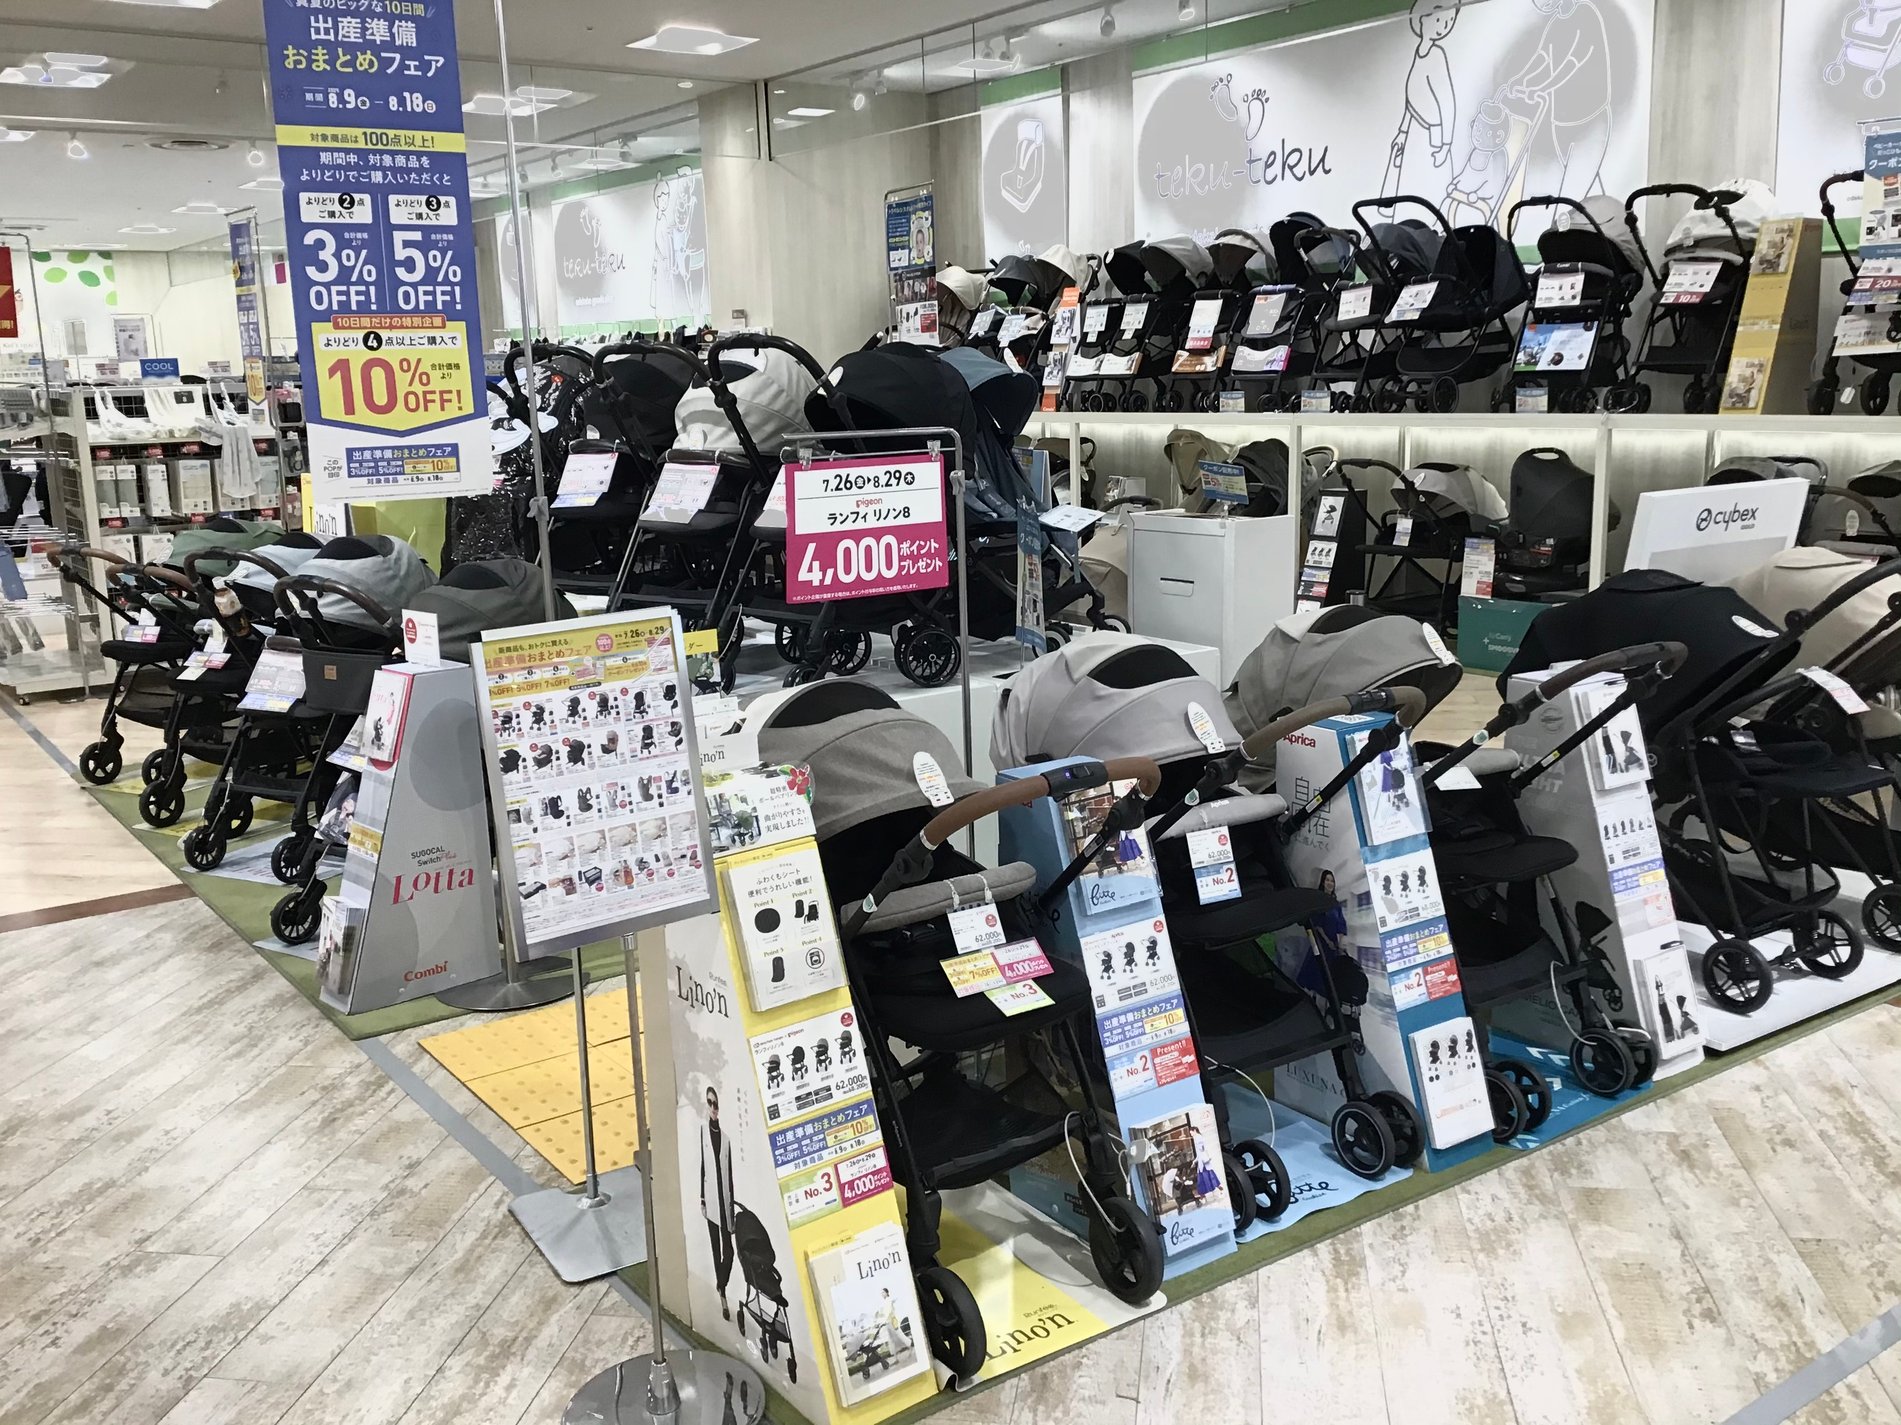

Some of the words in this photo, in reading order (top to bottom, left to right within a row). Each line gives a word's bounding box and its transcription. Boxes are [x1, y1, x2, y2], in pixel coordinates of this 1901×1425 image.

[310, 14, 417, 47] 出産準備
[283, 44, 445, 77] おまとめフェア
[319, 152, 431, 168] 期間中、対象商品を
[1155, 138, 1332, 199] teku-teku
[1868, 158, 1901, 170] クーポ
[300, 168, 452, 186] よりどりでご購入いただくと
[318, 209, 355, 220] ご購入で
[406, 211, 441, 222] ご購入で
[309, 285, 377, 311] OFF!
[397, 285, 462, 311] OFF!
[336, 315, 443, 329] 10日間だけの特別企画
[144, 362, 174, 371] COOL
[430, 361, 461, 371] 合計価格
[439, 371, 453, 380] より
[403, 389, 463, 413] OFF!
[352, 446, 452, 460] 出産準備おまとめフェア
[1713, 502, 1759, 531] cybex
[900, 539, 939, 556] ポイント
[797, 534, 900, 587] 4,000
[900, 557, 943, 575] プレゼント
[700, 749, 726, 766] ino'n
[411, 845, 446, 859] SUGOCAL
[417, 856, 441, 867] Switch
[756, 867, 801, 886] ふわくもシート
[1212, 867, 1236, 886] No.2
[391, 867, 475, 906] Lotta
[748, 875, 813, 898] 便利でうれしい機能!
[404, 960, 448, 982] Combi
[675, 965, 729, 1018] Lino'n
[1404, 972, 1423, 992] No.2
[1010, 983, 1038, 1001] No.3
[1126, 1054, 1150, 1078] No.2
[775, 1104, 868, 1147] 出産準備おまとめフェア
[804, 1172, 833, 1200] No.3
[844, 1174, 875, 1198] 4,000
[857, 1250, 902, 1280] Lino'n
